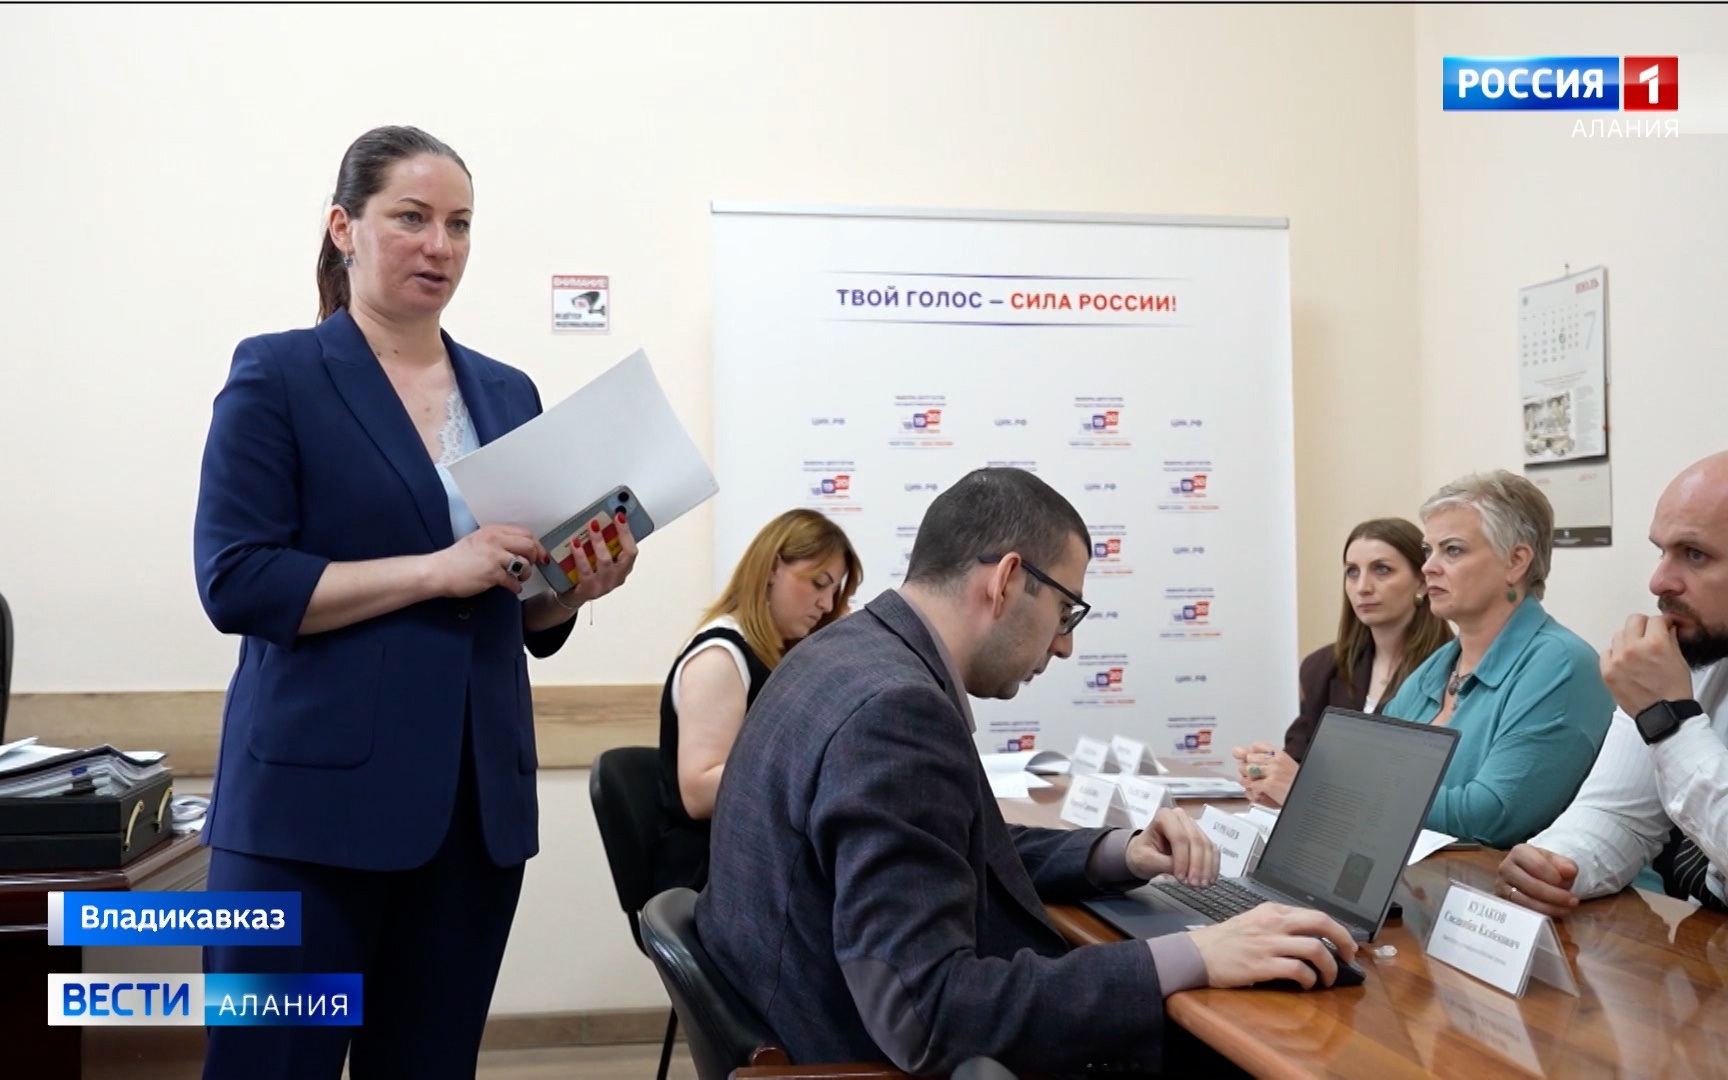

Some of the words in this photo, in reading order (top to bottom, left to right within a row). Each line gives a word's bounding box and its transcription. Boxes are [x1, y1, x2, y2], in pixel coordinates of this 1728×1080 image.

[836, 286, 899, 306] ТВОЙ
[906, 289, 983, 309] ГОЛОС
[1011, 292, 1072, 311] СИЛА
[1079, 293, 1177, 312] РОССИИ!
